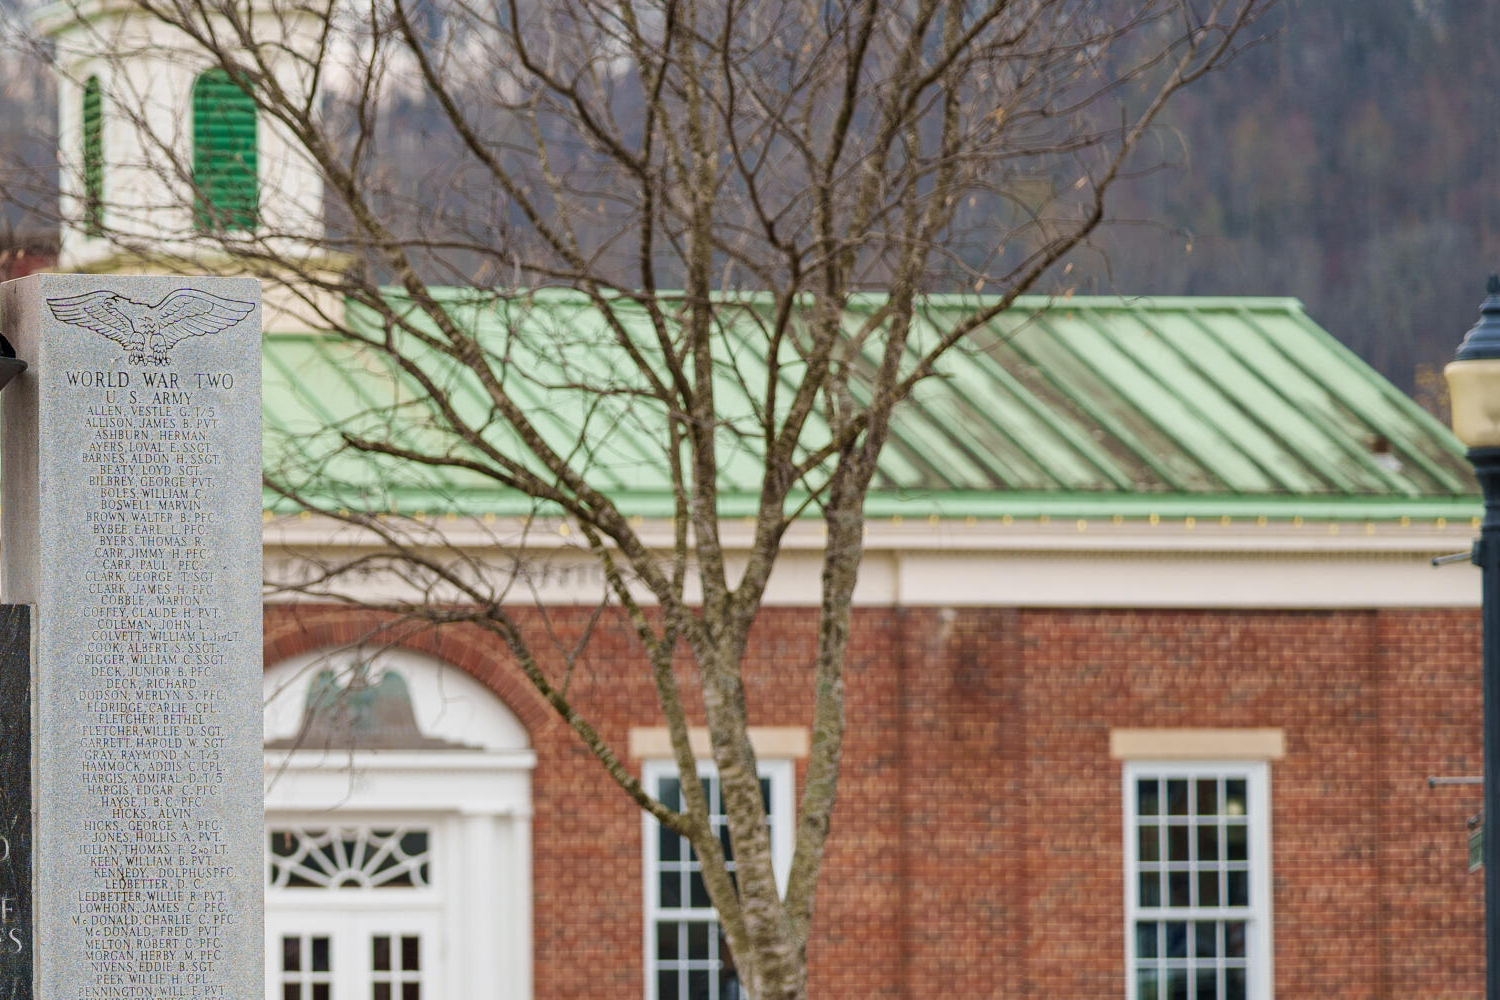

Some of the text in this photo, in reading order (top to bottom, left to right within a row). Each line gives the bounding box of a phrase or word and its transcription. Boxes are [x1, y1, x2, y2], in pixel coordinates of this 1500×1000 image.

[67, 371, 234, 389] WORLD WAR TWO
[153, 392, 193, 405] ARMY
[147, 679, 197, 688] RICHARD
[159, 809, 191, 818] ALVIN
